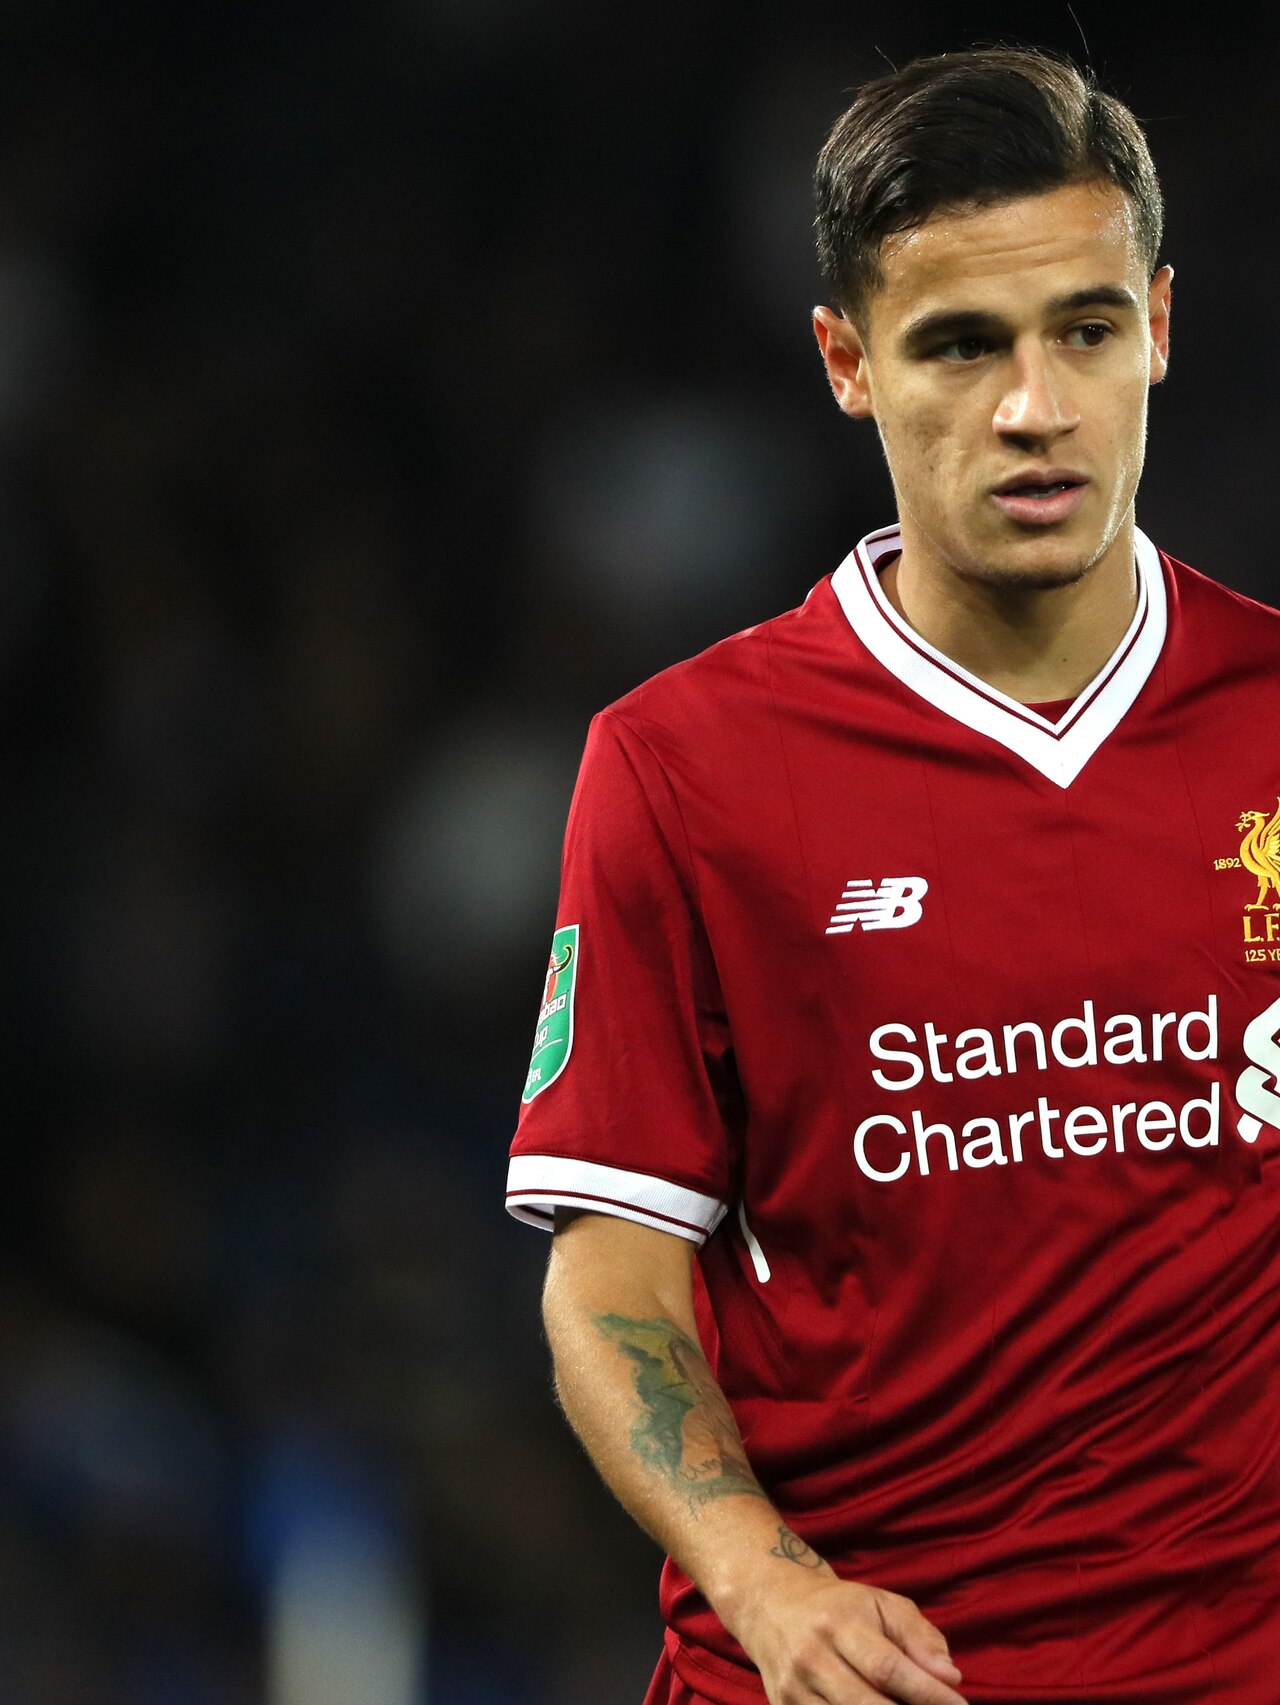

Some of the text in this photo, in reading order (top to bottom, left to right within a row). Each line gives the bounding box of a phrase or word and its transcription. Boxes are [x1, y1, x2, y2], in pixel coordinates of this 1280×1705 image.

[1213, 857, 1242, 871] 1892
[1245, 950, 1267, 963] 125
[868, 994, 1220, 1092] Standard
[853, 1081, 1221, 1184] Chartered
